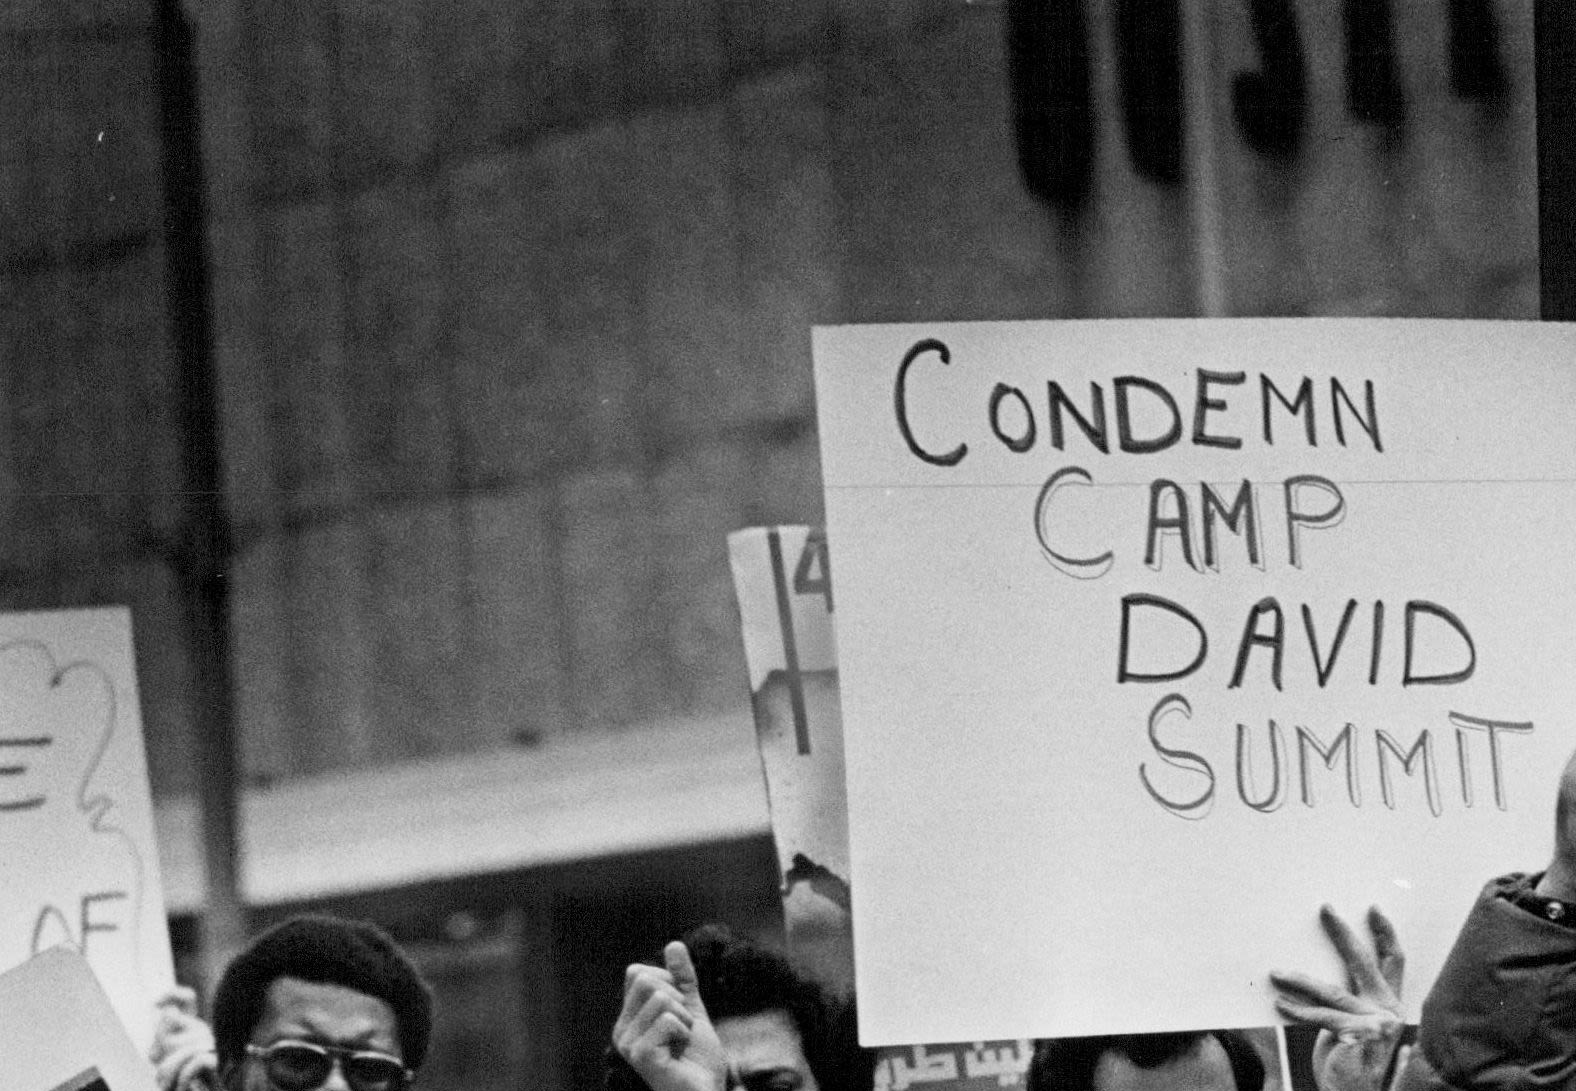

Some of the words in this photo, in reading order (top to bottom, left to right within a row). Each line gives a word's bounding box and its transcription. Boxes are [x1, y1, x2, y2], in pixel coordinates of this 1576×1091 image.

[893, 338, 1385, 466] CONDEMN
[1033, 465, 1348, 580] CAMP
[1117, 593, 1478, 692] DAVID
[1138, 693, 1534, 821] SUMMIT
